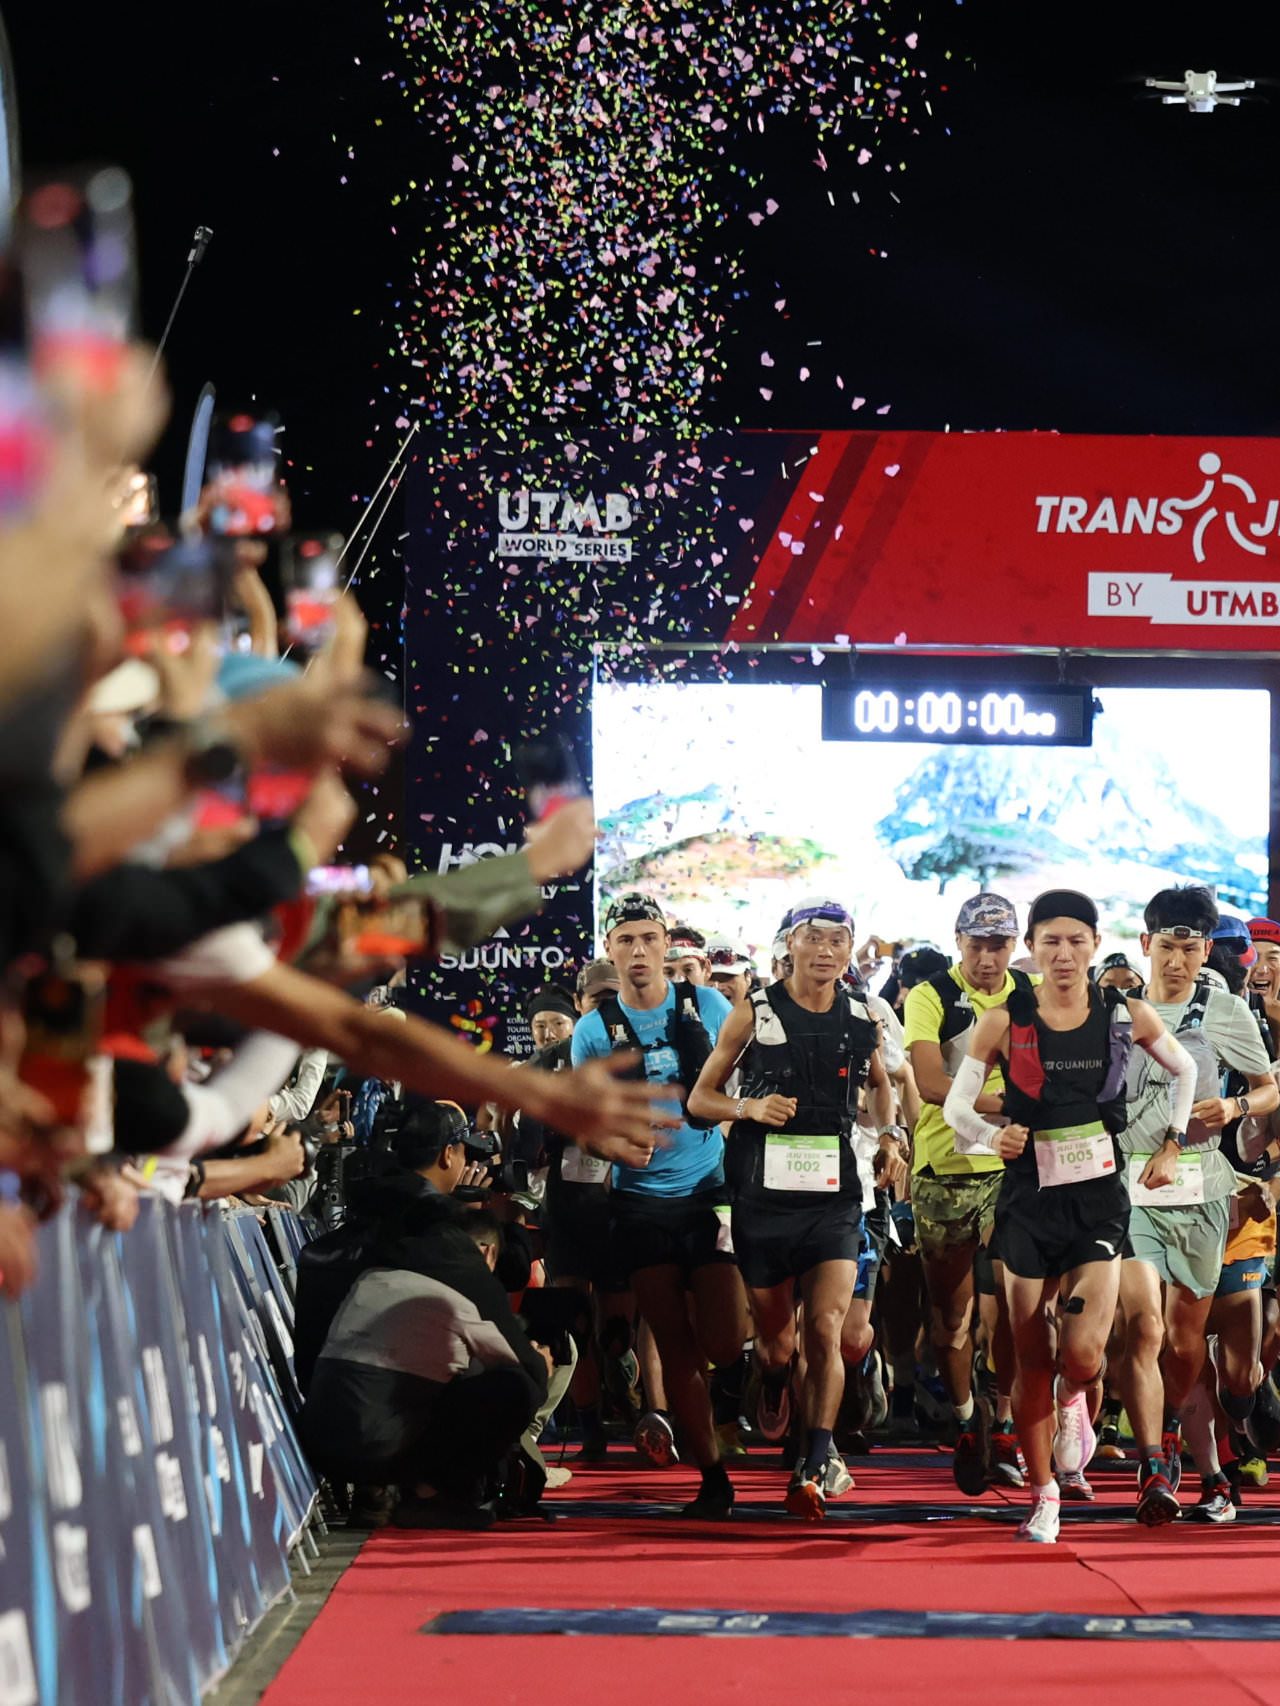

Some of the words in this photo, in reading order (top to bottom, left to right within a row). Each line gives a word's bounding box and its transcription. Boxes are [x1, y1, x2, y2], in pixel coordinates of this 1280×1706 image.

[498, 490, 632, 533] UTMB
[1035, 495, 1184, 536] TRANS
[504, 538, 567, 553] WORLD
[574, 542, 627, 557] SERIES
[1106, 582, 1143, 607] BY
[1186, 590, 1279, 618] UTMB
[786, 1160, 821, 1172] 1002
[1059, 1148, 1094, 1165] 1005
